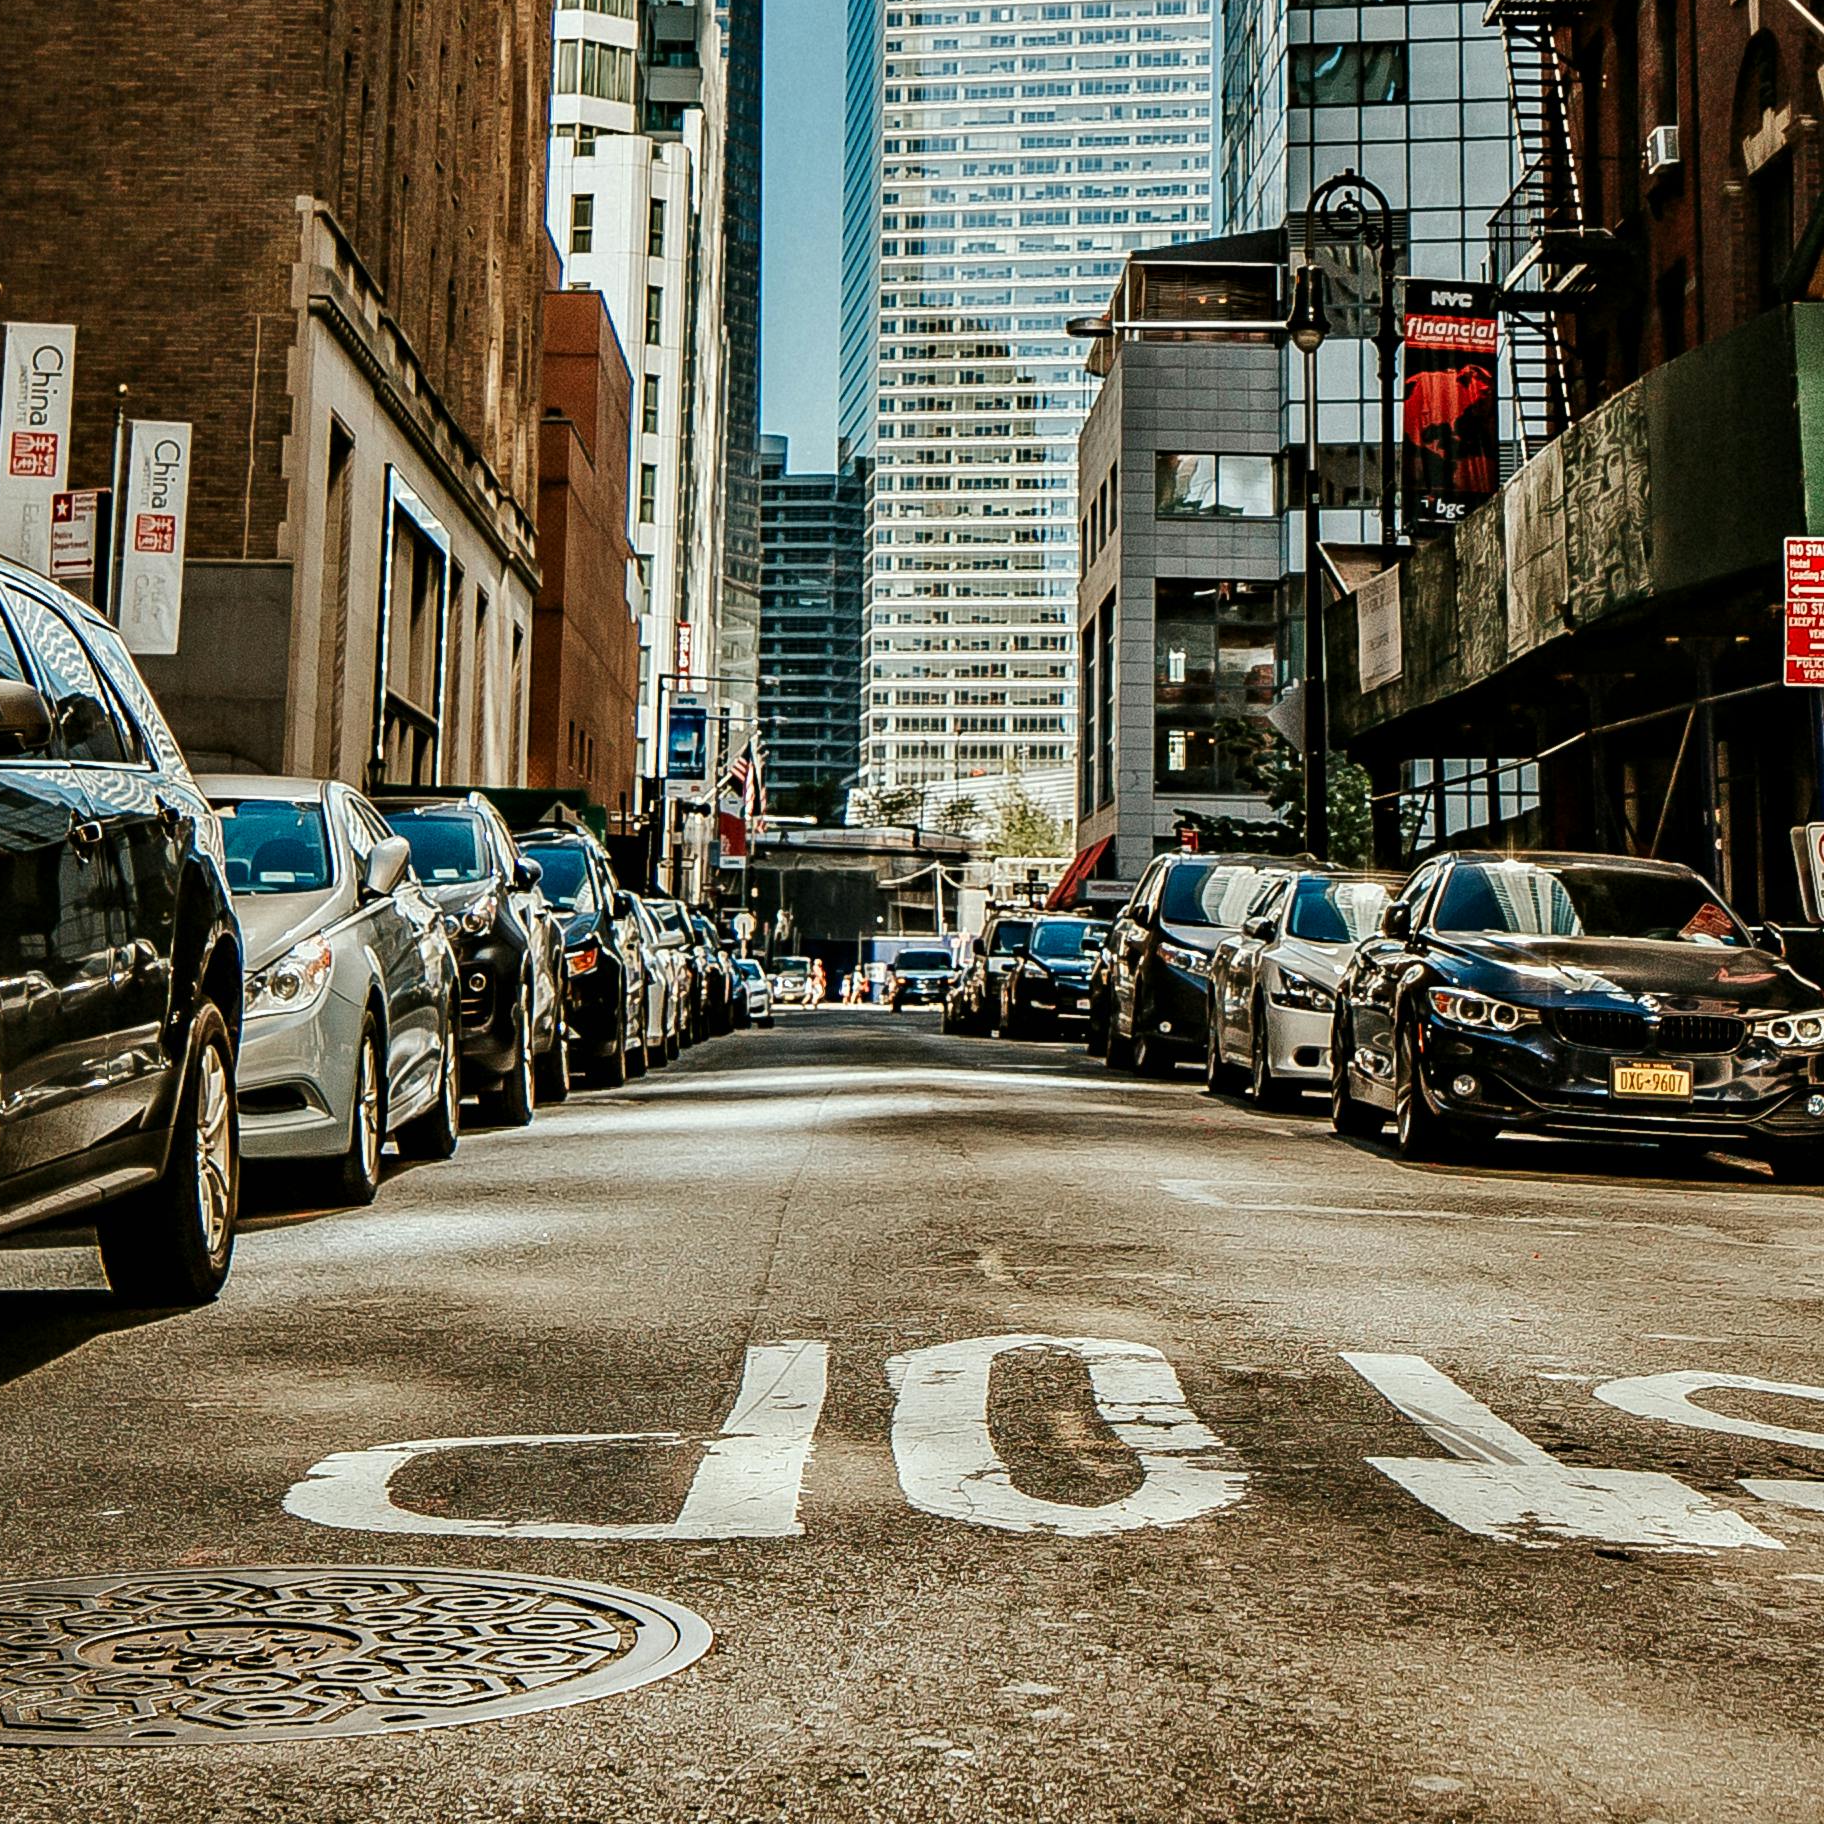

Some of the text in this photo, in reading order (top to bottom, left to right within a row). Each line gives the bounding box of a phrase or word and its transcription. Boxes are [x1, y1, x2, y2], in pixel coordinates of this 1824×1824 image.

[1431, 290, 1473, 308] NYC
[1407, 317, 1496, 339] financial
[29, 344, 64, 426] China
[151, 439, 181, 509] China
[1436, 498, 1466, 518] bgc
[1789, 543, 1804, 557] NO
[1789, 570, 1819, 583] Loading
[1792, 602, 1808, 615] NO
[1788, 617, 1816, 627] EXCEPT
[1652, 1073, 1684, 1093] 9607
